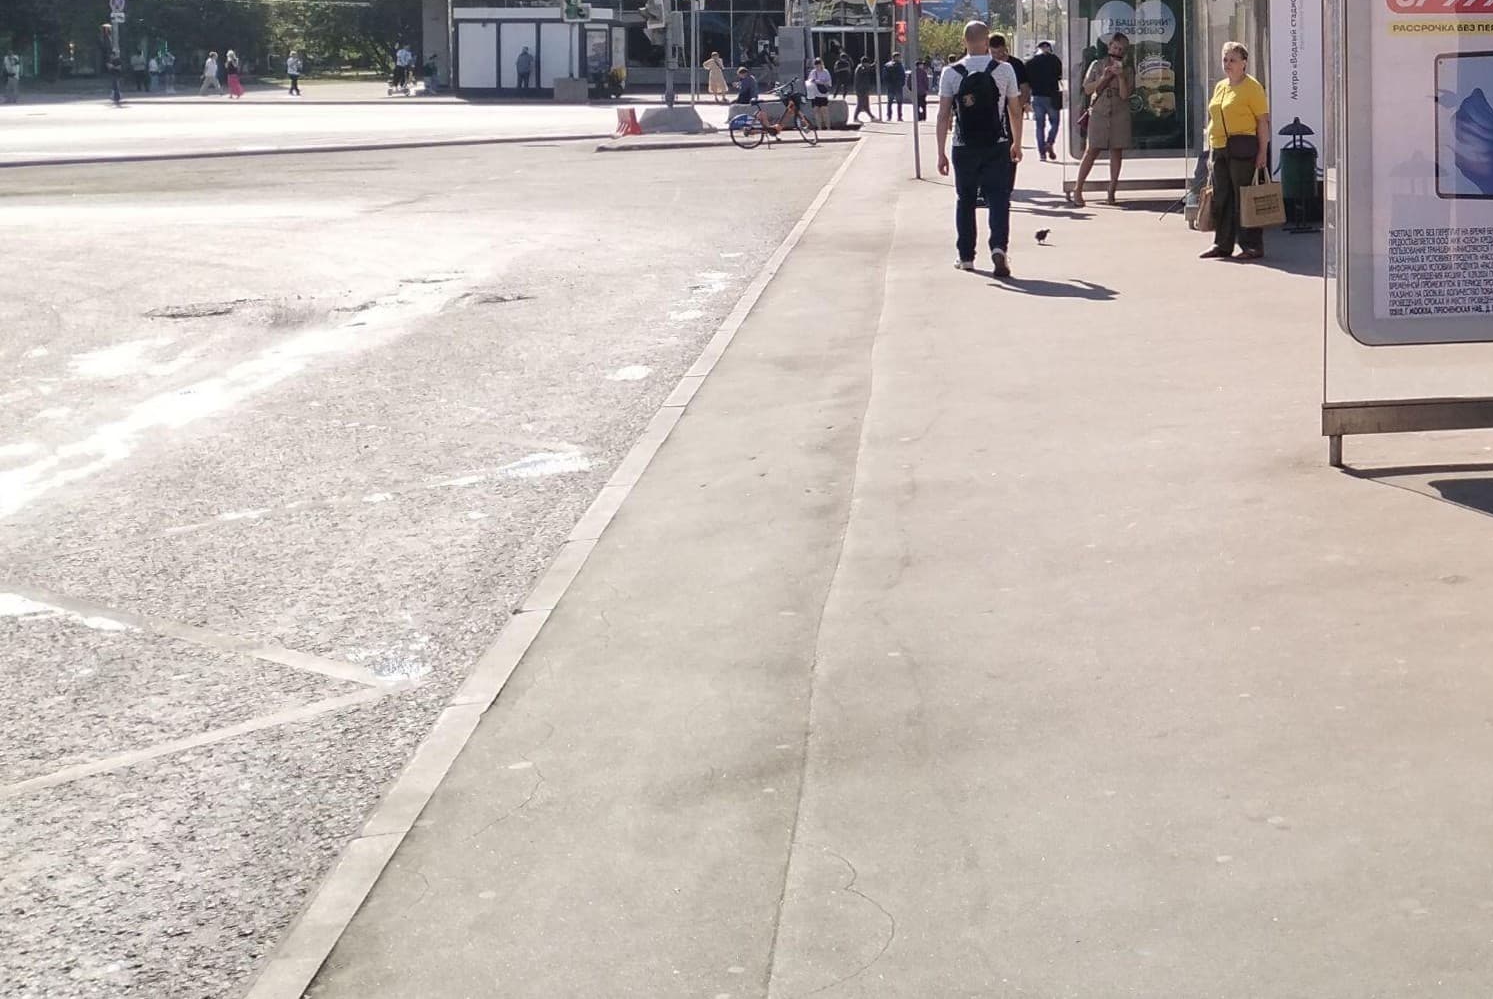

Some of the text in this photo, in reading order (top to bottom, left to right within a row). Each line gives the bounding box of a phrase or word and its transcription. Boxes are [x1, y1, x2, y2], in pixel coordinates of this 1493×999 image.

[1393, 24, 1455, 32] РАССРОЧКА
[1457, 23, 1475, 32] БЕЗ
[1290, 69, 1300, 100] Метро
